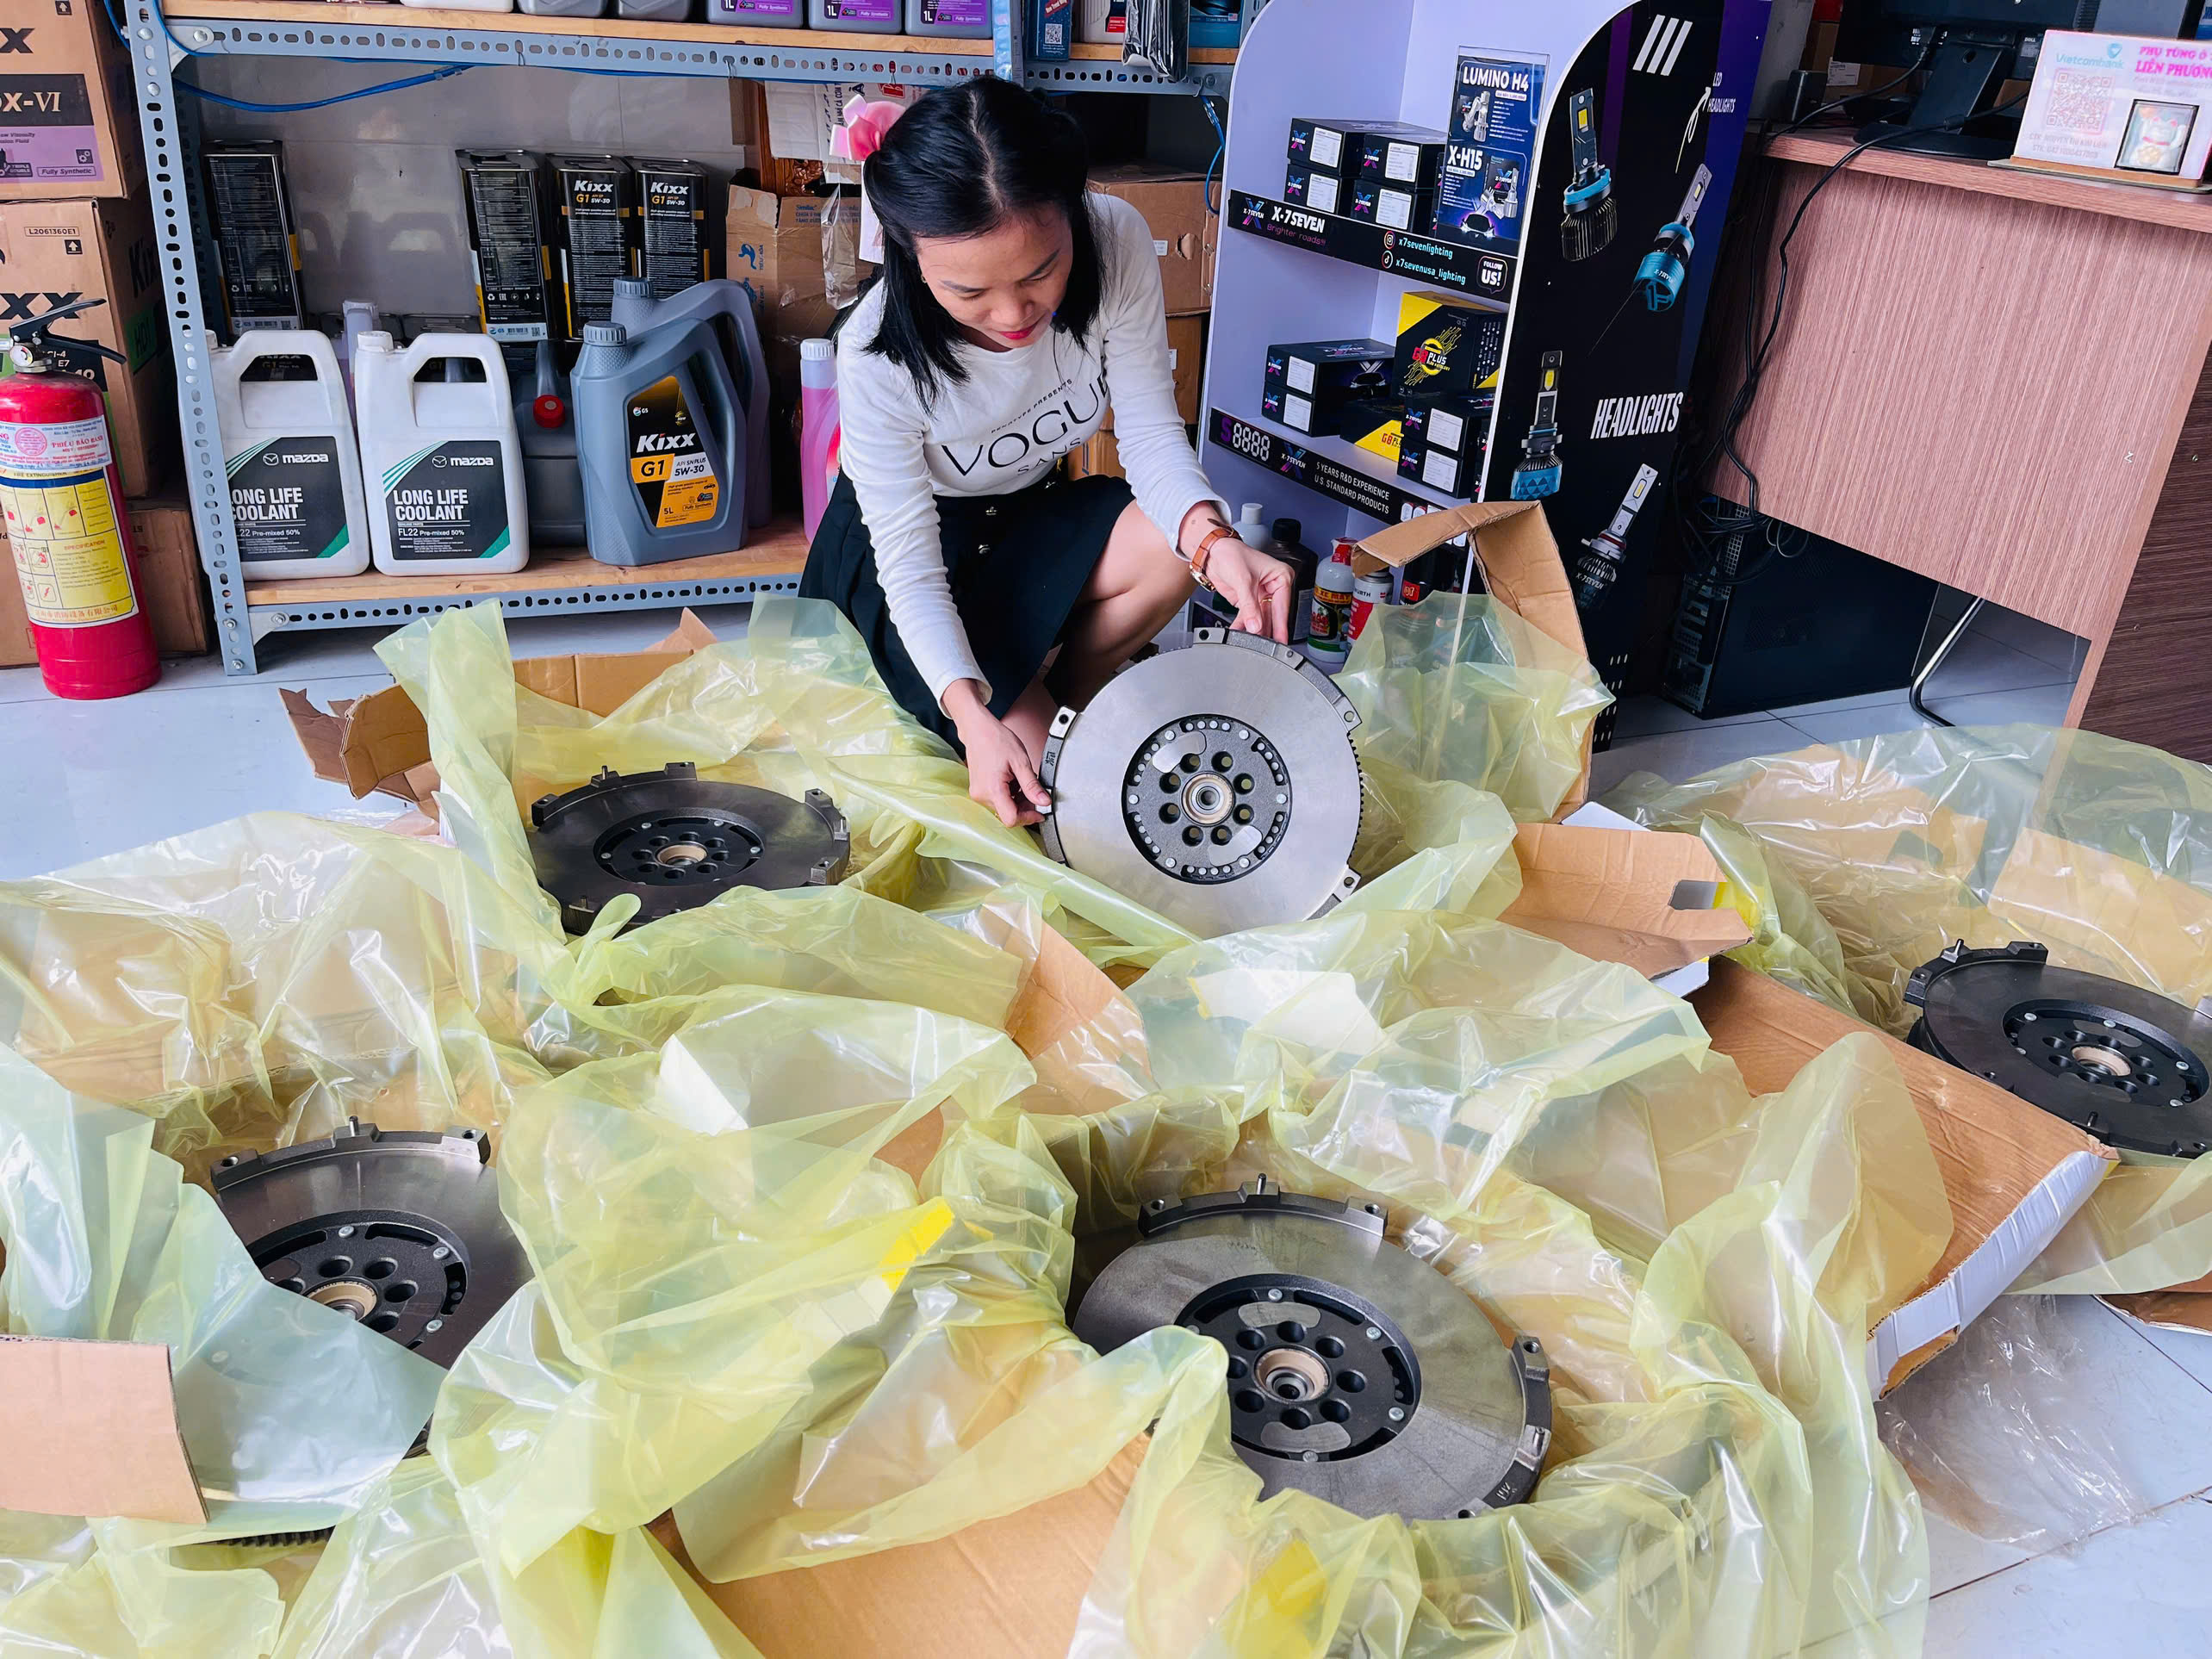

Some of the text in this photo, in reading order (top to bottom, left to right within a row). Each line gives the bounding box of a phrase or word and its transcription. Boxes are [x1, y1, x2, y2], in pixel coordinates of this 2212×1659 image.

[827, 5, 837, 16] 1L
[923, 10, 933, 21] 1L
[2056, 53, 2124, 69] Vietcombank
[1463, 66, 1529, 92] LUMINO H4
[0, 91, 61, 112] X-VI
[575, 179, 613, 192] Kixx
[650, 182, 689, 195] Kixx
[576, 194, 588, 203] G1
[652, 196, 664, 204] G1
[1267, 224, 1296, 237] Brighter
[1399, 238, 1453, 259] x7sevenlighting
[1395, 258, 1466, 285] x7sevenusa_lighting
[1483, 260, 1503, 270] FOLLOW
[1481, 269, 1501, 287] US!
[1427, 351, 1447, 365] PLUS
[1590, 391, 1684, 439] HEADLIGHTS
[637, 433, 696, 453] Kixx
[283, 453, 329, 463] mazda
[450, 457, 494, 466] mazda
[1017, 438, 1081, 475] SANS
[641, 460, 664, 476] G1
[674, 465, 705, 476] 5W-30
[1316, 461, 1390, 501] 5 YEARS R&D EXPERIENCE
[269, 488, 303, 503] LIFE
[393, 488, 469, 506] LONG LIFE
[1326, 480, 1357, 500] STANDARD
[1357, 493, 1389, 514] PRODUCTS
[395, 505, 464, 521] COOLANT
[64, 539, 105, 550] SPECIFICATION
